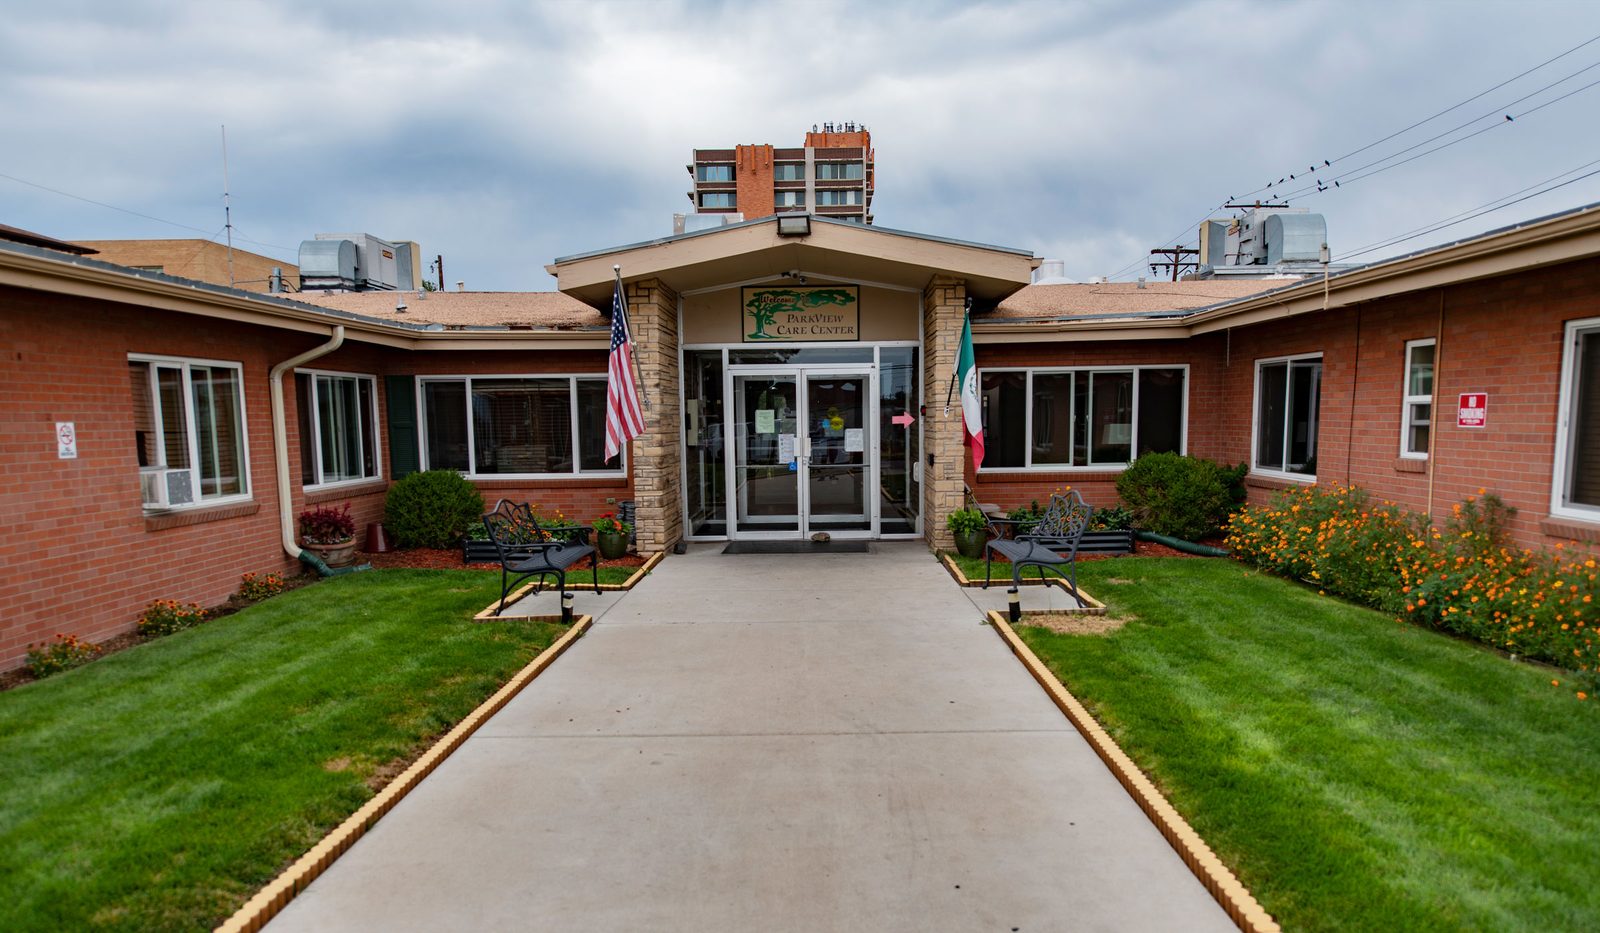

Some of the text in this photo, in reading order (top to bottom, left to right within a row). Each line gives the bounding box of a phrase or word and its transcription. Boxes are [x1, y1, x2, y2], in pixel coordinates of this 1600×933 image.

[787, 313, 844, 323] PARKVIEW
[777, 325, 854, 335] CARE CENTER
